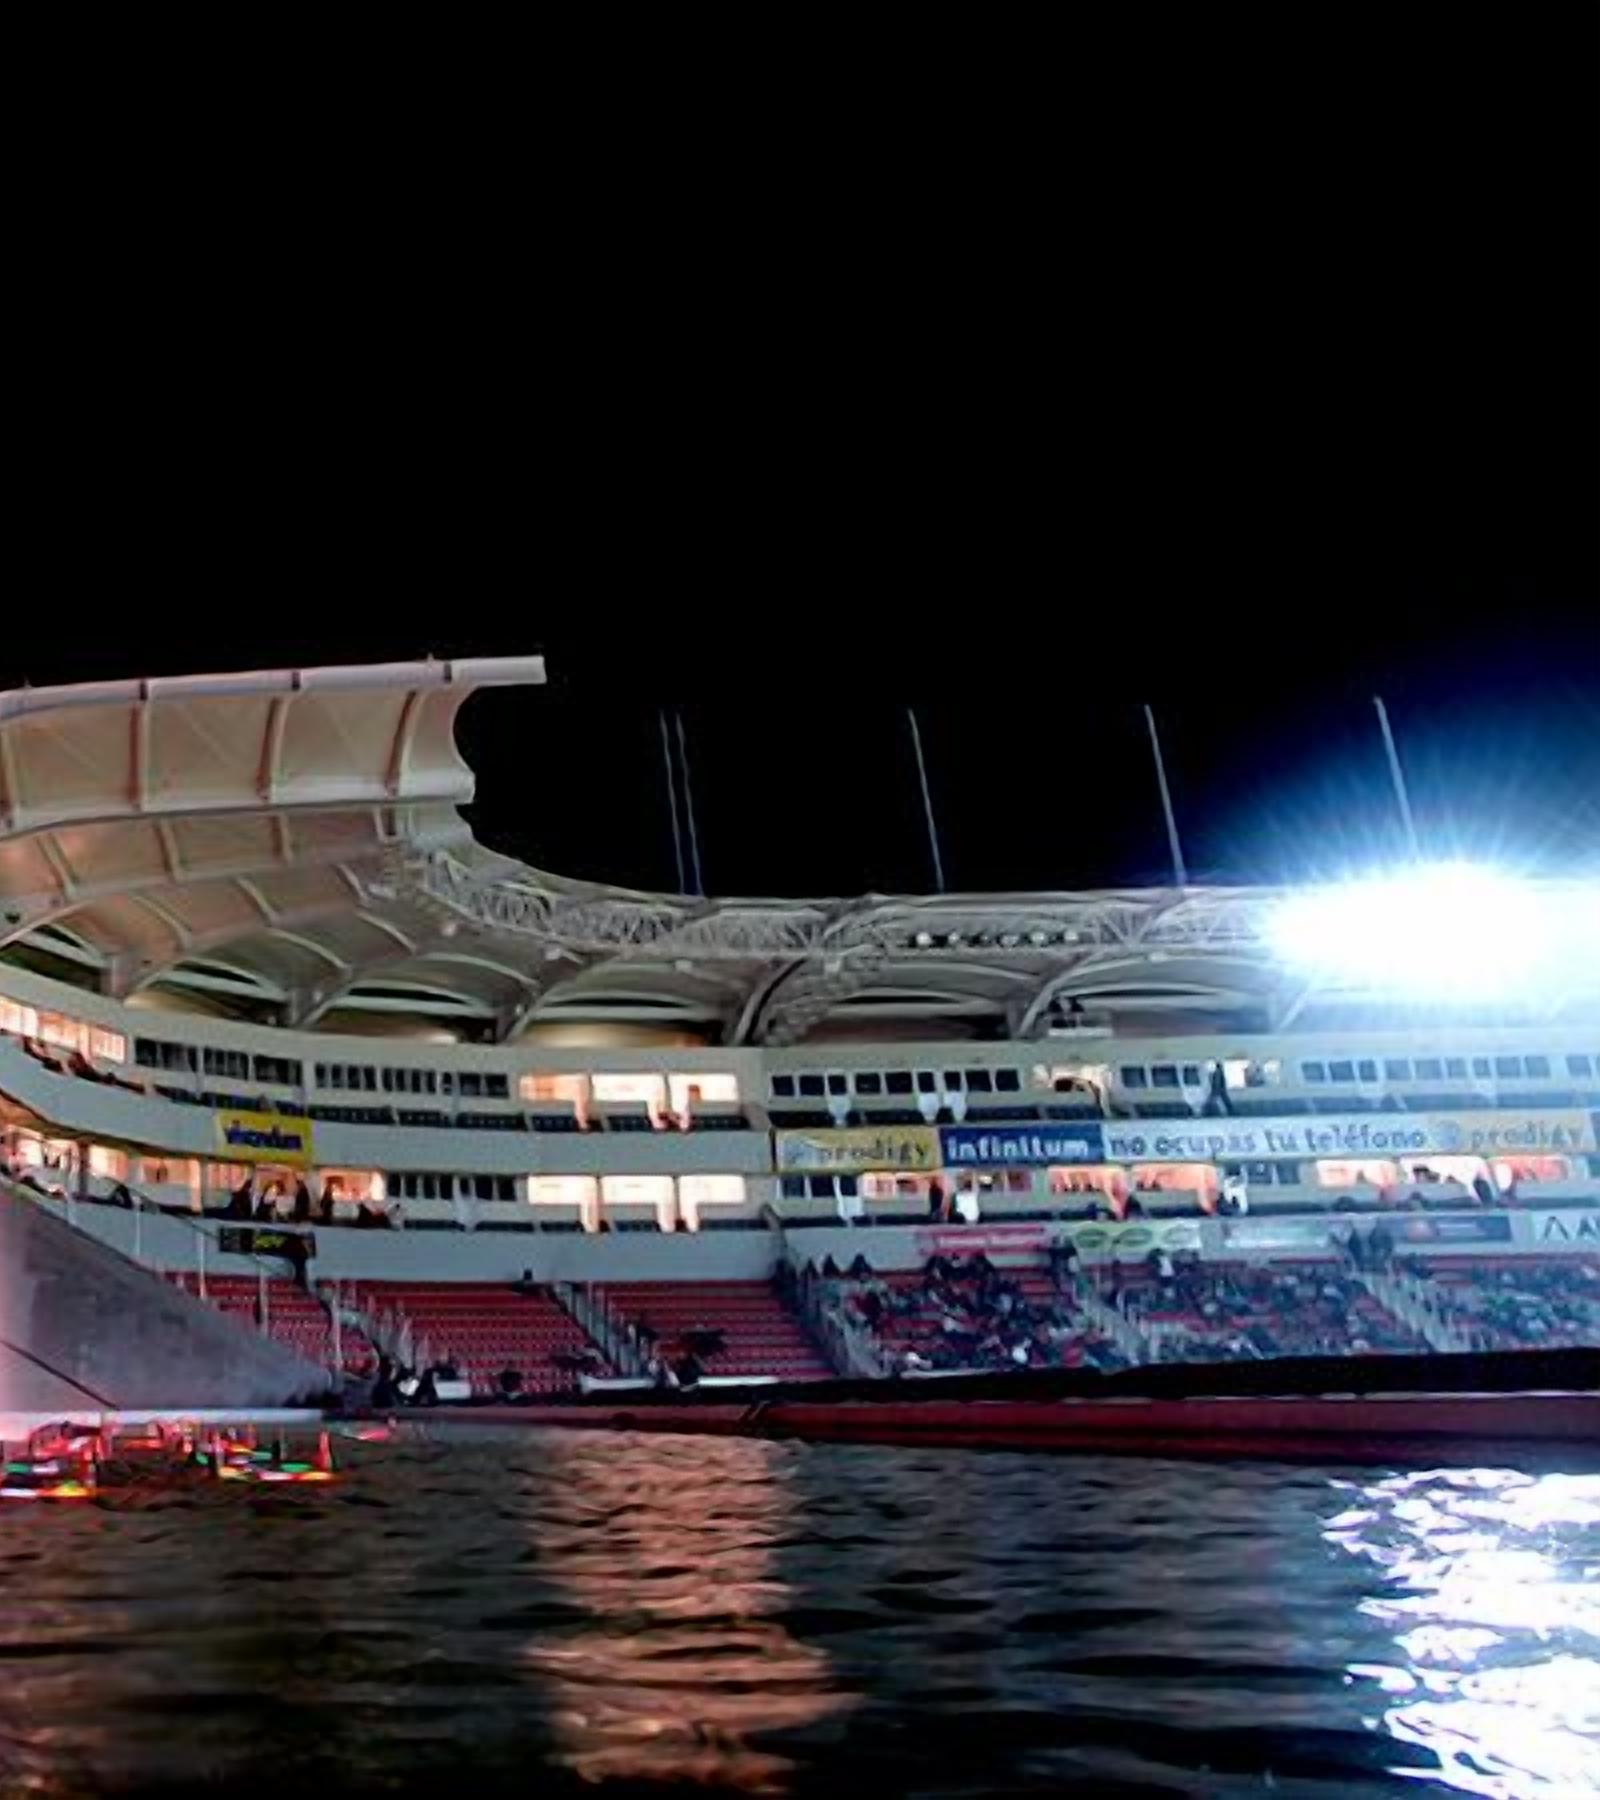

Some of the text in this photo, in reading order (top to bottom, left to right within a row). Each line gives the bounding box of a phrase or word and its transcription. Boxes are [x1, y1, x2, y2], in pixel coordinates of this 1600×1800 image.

[947, 1135, 1088, 1160] infinitum
[1110, 1123, 1426, 1159] no ocupas tu teléfono
